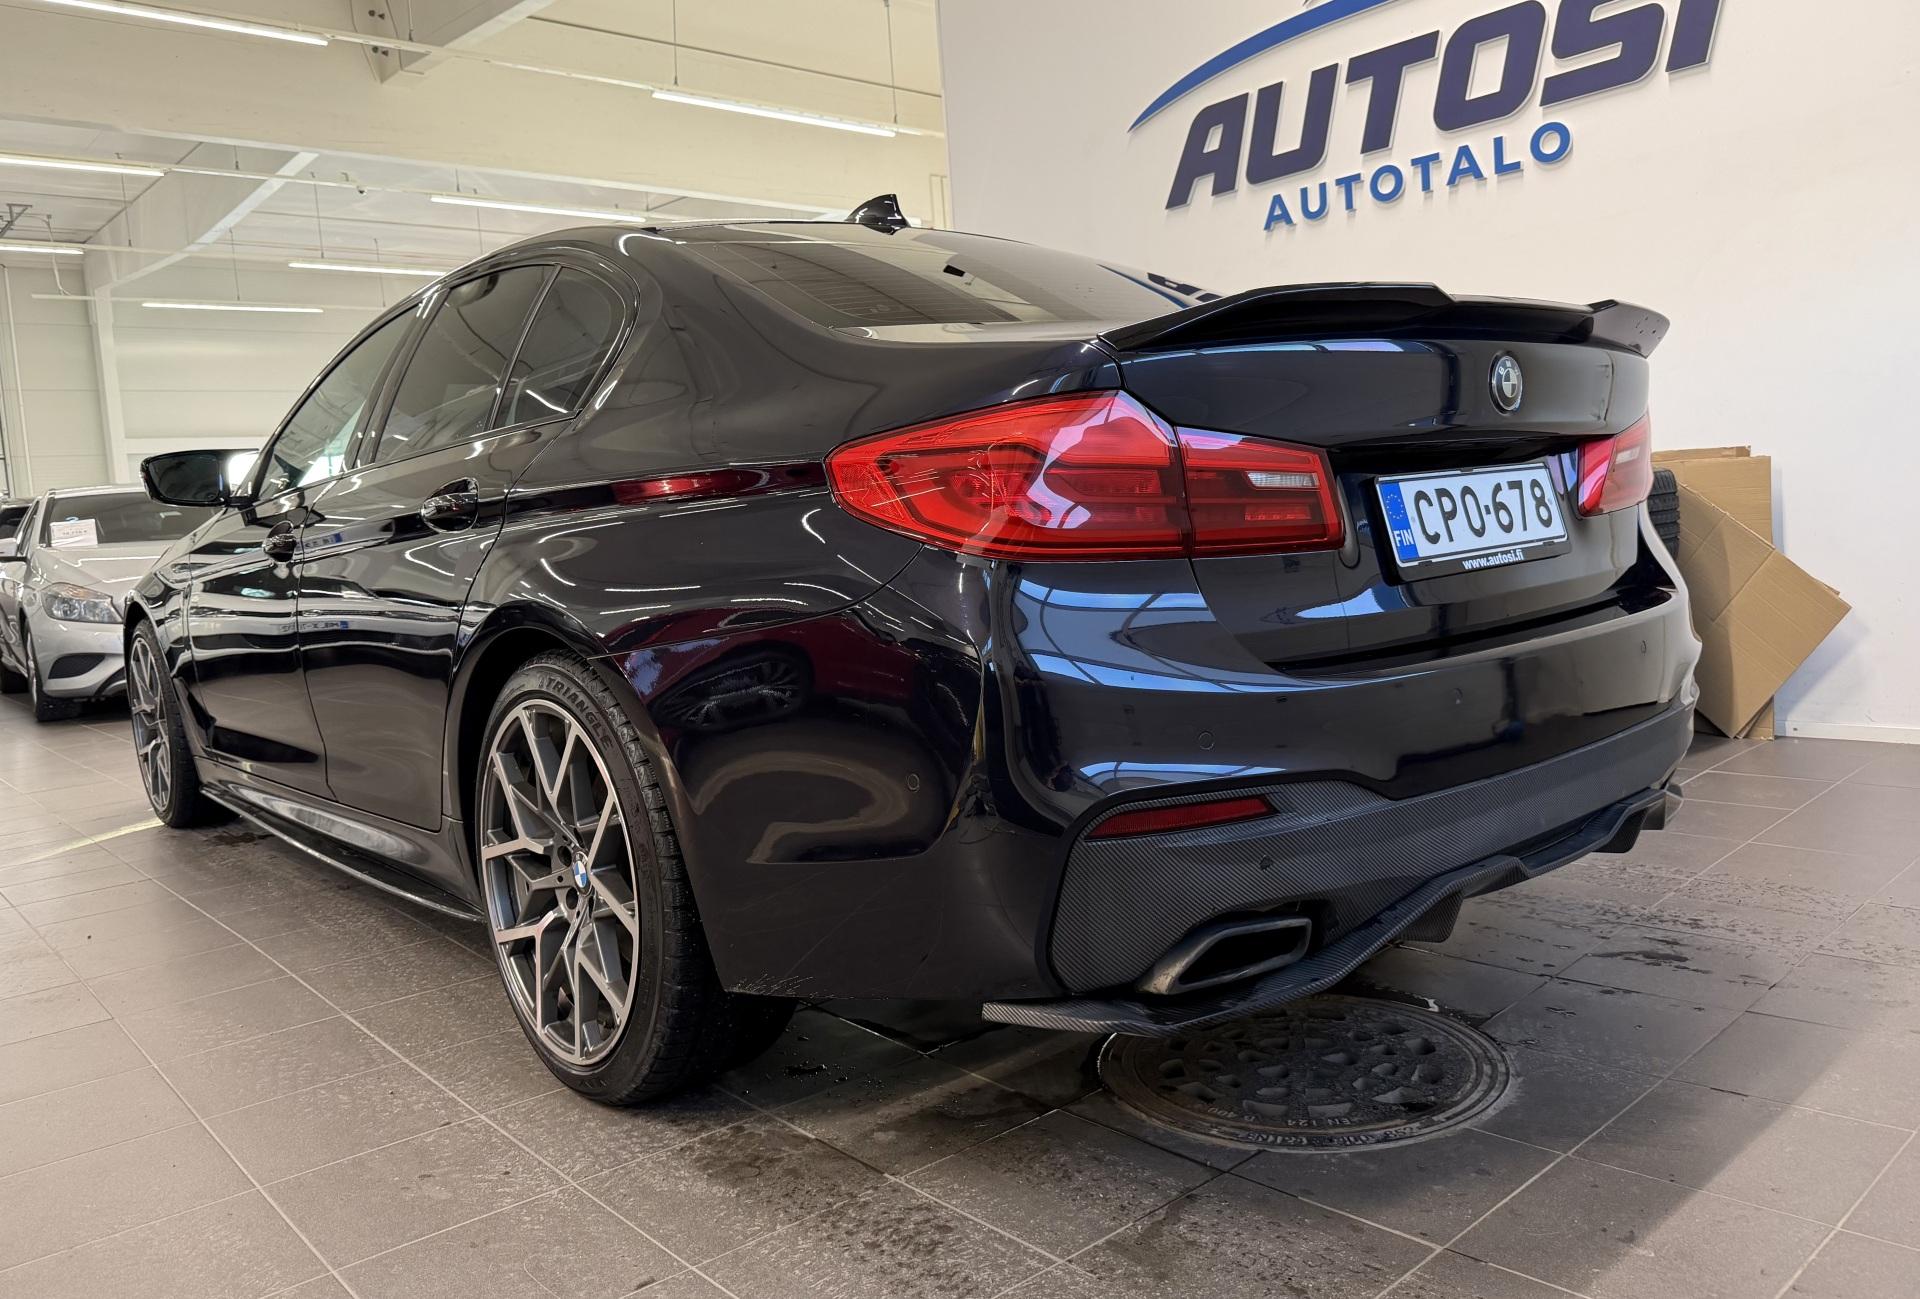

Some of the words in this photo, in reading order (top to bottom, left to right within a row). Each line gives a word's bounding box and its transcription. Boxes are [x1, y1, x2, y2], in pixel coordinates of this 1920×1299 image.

[1263, 121, 1572, 231] AUTOTALO
[1393, 528, 1415, 548] FIN
[1414, 478, 1553, 545] CPO-678
[1462, 549, 1524, 570] www.autosi.fi
[545, 677, 615, 752] TRIANGLE
